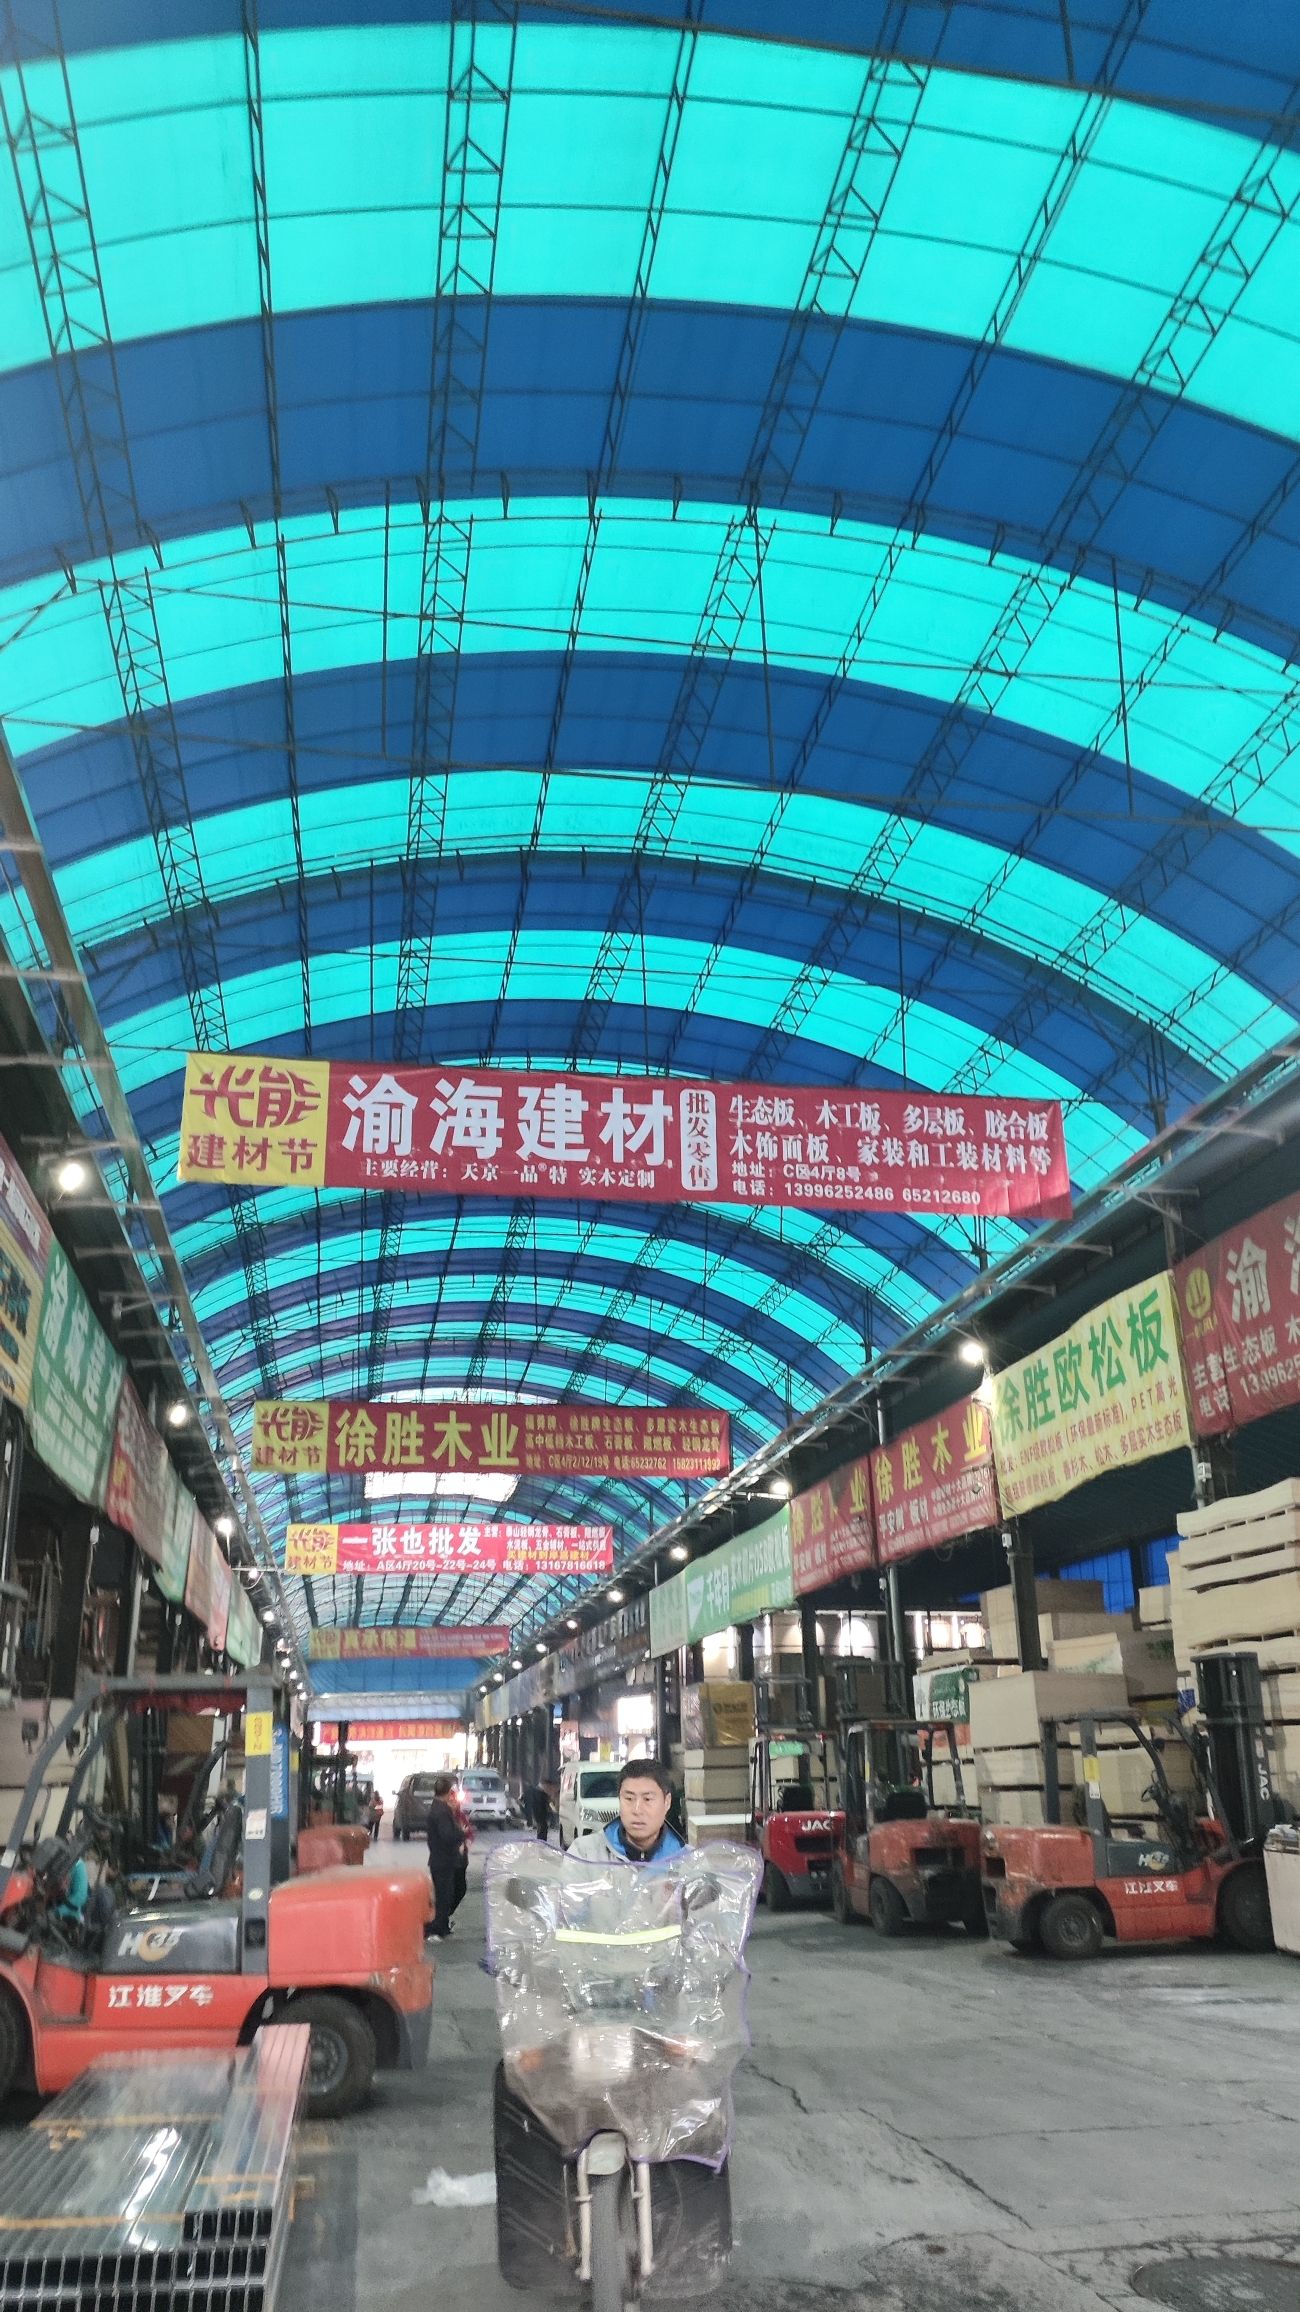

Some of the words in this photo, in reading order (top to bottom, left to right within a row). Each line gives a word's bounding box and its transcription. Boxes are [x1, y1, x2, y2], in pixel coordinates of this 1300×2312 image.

[341, 1073, 673, 1166] 渝海建材
[686, 1092, 711, 1188] 批发零售
[187, 1134, 317, 1174] 建材节
[902, 1188, 981, 1205] 65212680
[997, 1288, 1169, 1446] 徐胜欧松板
[335, 1408, 520, 1467] 徐胜木业
[875, 1403, 987, 1504] 徐胜木业
[791, 1466, 867, 1546] 徐胜业
[342, 1526, 482, 1555] 一张也批发
[1258, 1764, 1270, 1801] JAC
[802, 1819, 832, 1831] JAC
